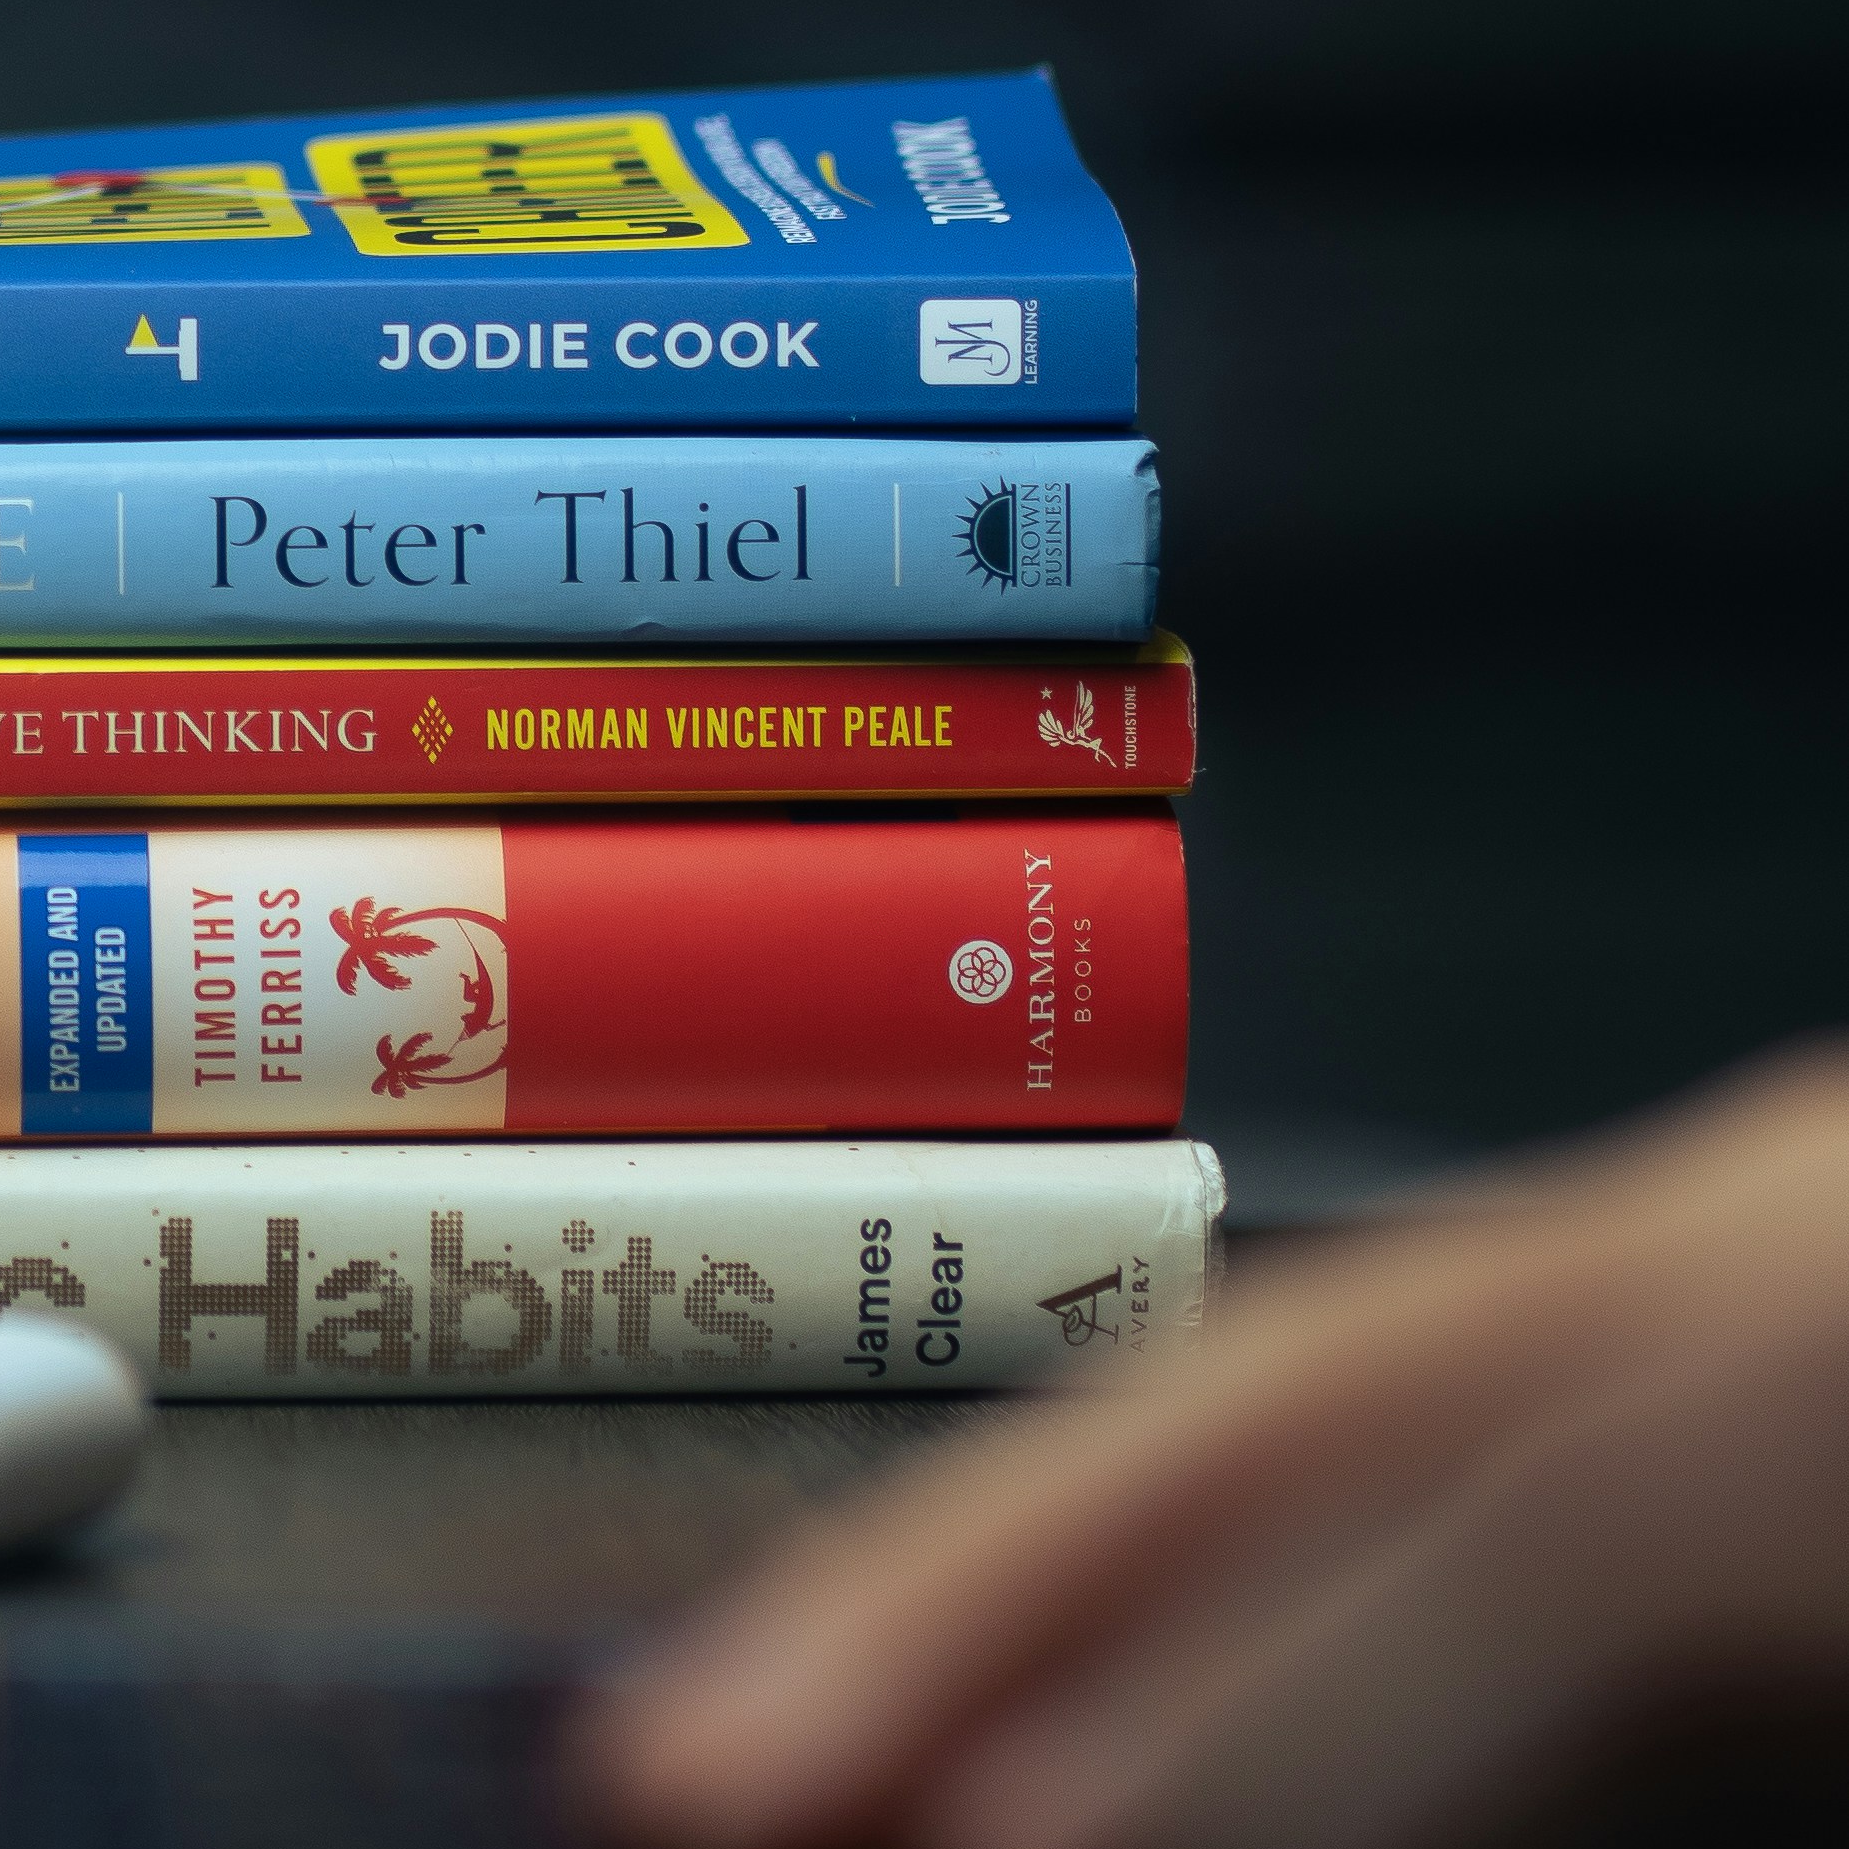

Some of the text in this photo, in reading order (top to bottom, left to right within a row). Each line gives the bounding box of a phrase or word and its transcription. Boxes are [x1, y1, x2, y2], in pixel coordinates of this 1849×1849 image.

[379, 322, 820, 370] JODIE COOK
[1024, 299, 1038, 385] LEARNING
[209, 484, 813, 588] Peter Thiel
[1020, 483, 1041, 588] CROWN
[1045, 481, 1064, 587] BUSINESS
[61, 709, 378, 754] THINKING
[487, 705, 953, 750] NORMAN VINCENT PEALE
[1123, 684, 1137, 770] TOUCHSTONE
[47, 886, 81, 1093] EXPANDED AND
[95, 925, 128, 1053] UPDATED
[192, 887, 237, 1088] TIMOTHY
[259, 887, 303, 1083] FERRISS
[1024, 848, 1055, 1091] HARMONY
[1074, 918, 1092, 1023] BOOKS
[158, 1209, 775, 1376] Habits
[843, 1217, 893, 1378] James
[915, 1231, 964, 1367] Clear
[1128, 1256, 1151, 1354] AVERY
